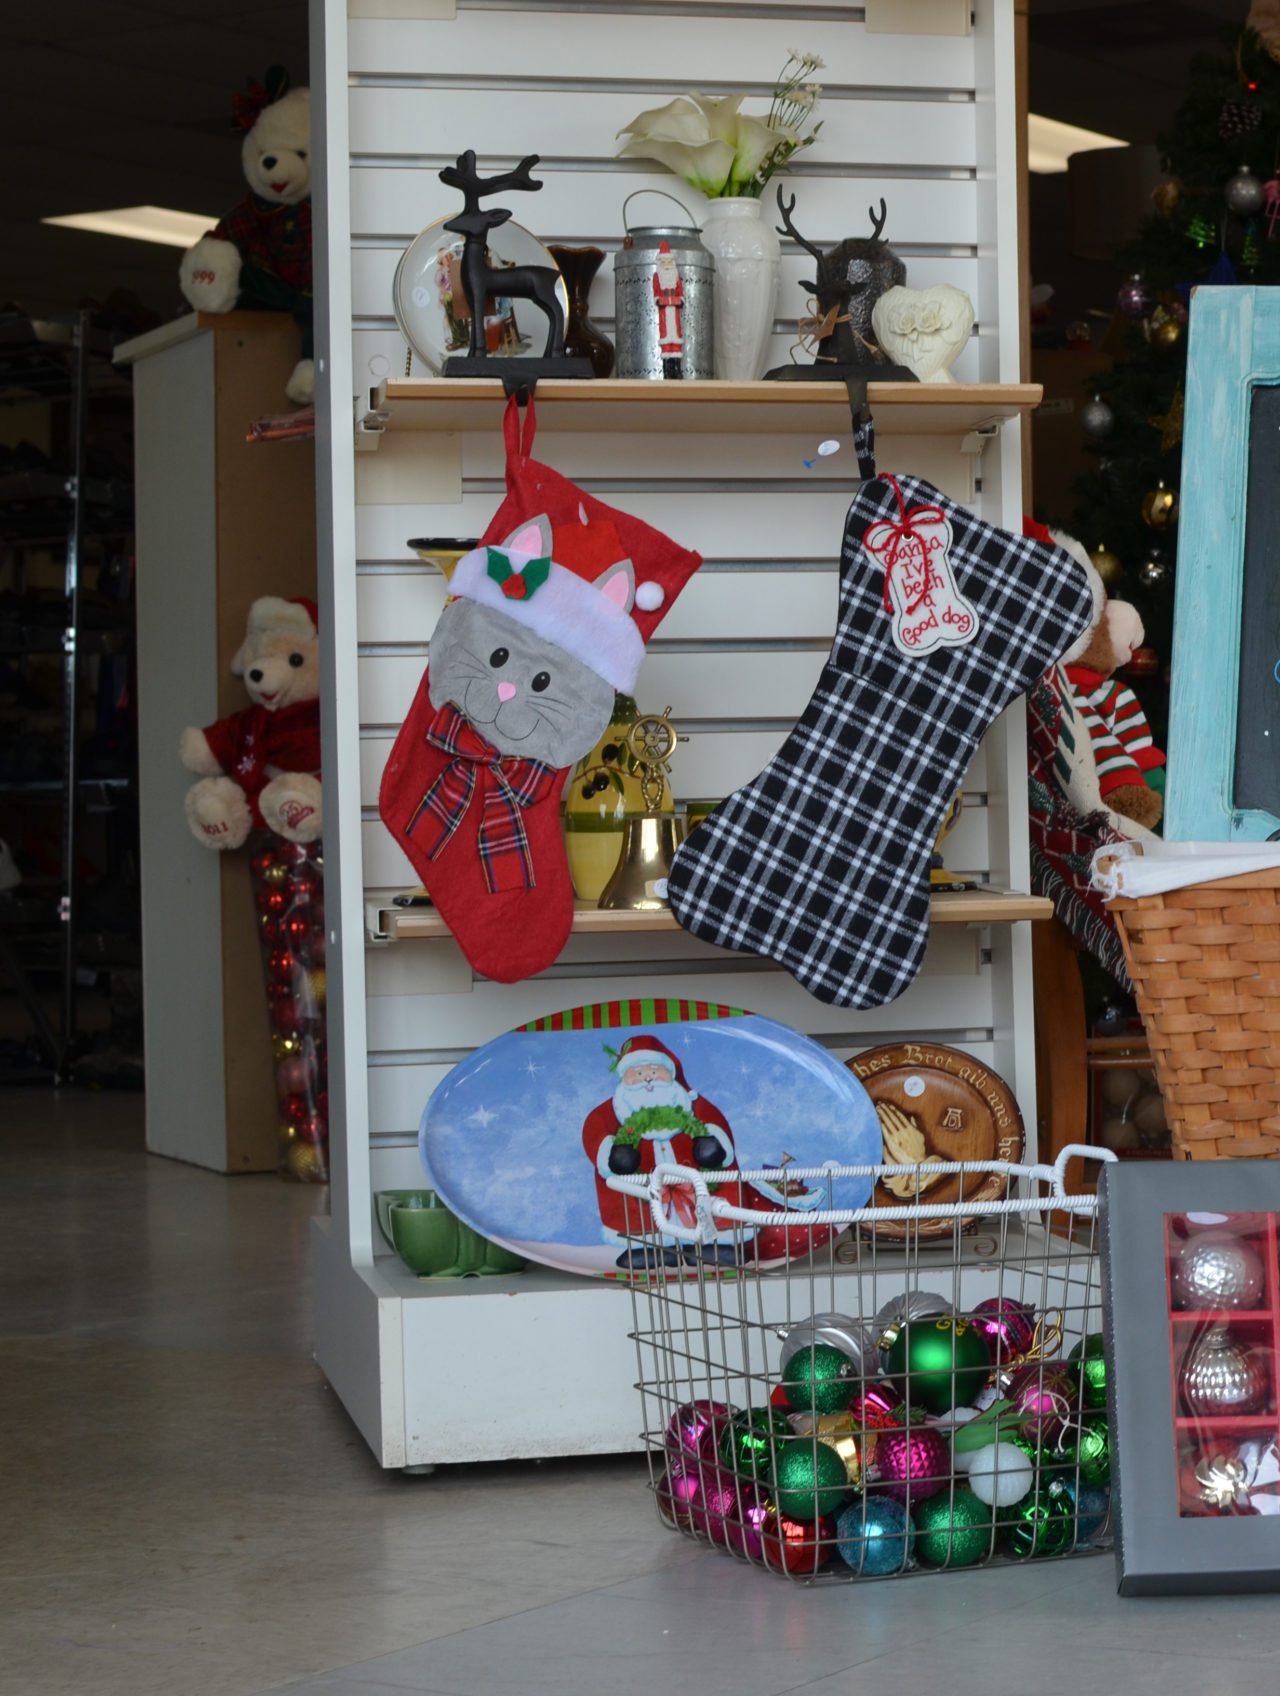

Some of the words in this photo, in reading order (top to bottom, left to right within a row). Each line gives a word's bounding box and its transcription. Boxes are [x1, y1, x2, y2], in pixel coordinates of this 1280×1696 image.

[901, 573, 945, 599] ben
[924, 593, 937, 608] a
[903, 608, 939, 646] Good
[942, 605, 971, 633] dog
[852, 1055, 892, 1077] hes
[902, 1044, 954, 1068] Brot
[987, 1091, 1012, 1128] uns
